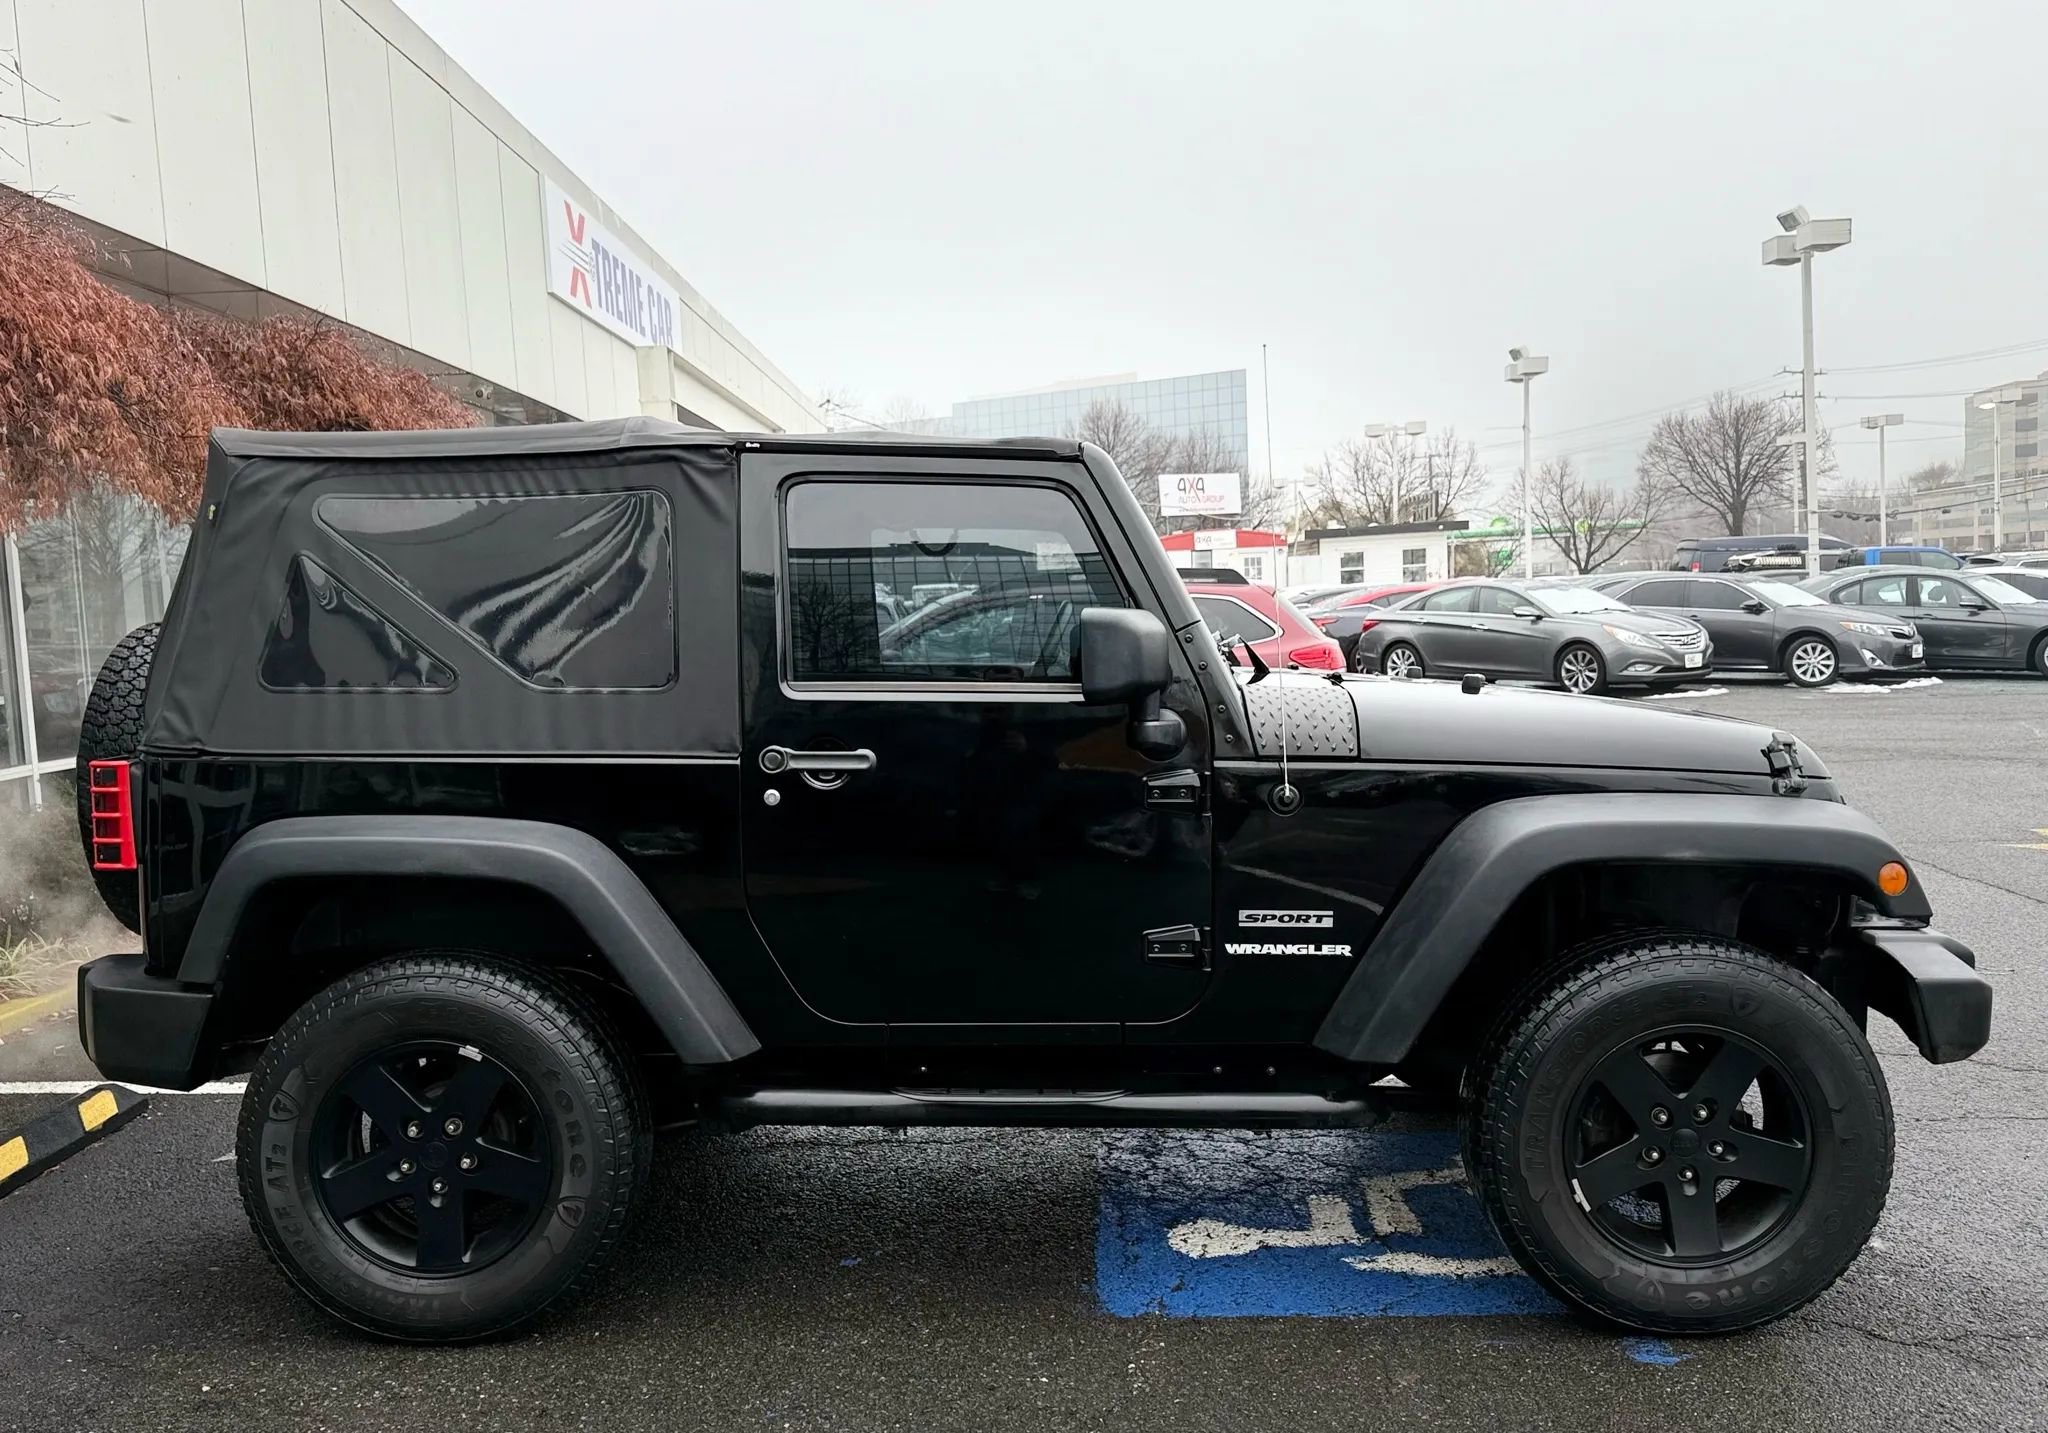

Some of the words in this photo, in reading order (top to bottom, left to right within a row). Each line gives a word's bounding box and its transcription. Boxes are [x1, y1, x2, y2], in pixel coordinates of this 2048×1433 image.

[647, 284, 674, 348] CAR
[1179, 495, 1197, 504] AUTO
[1202, 494, 1225, 503] GROUP
[1241, 912, 1333, 925] SPORT
[1225, 943, 1353, 957] WRANGLER
